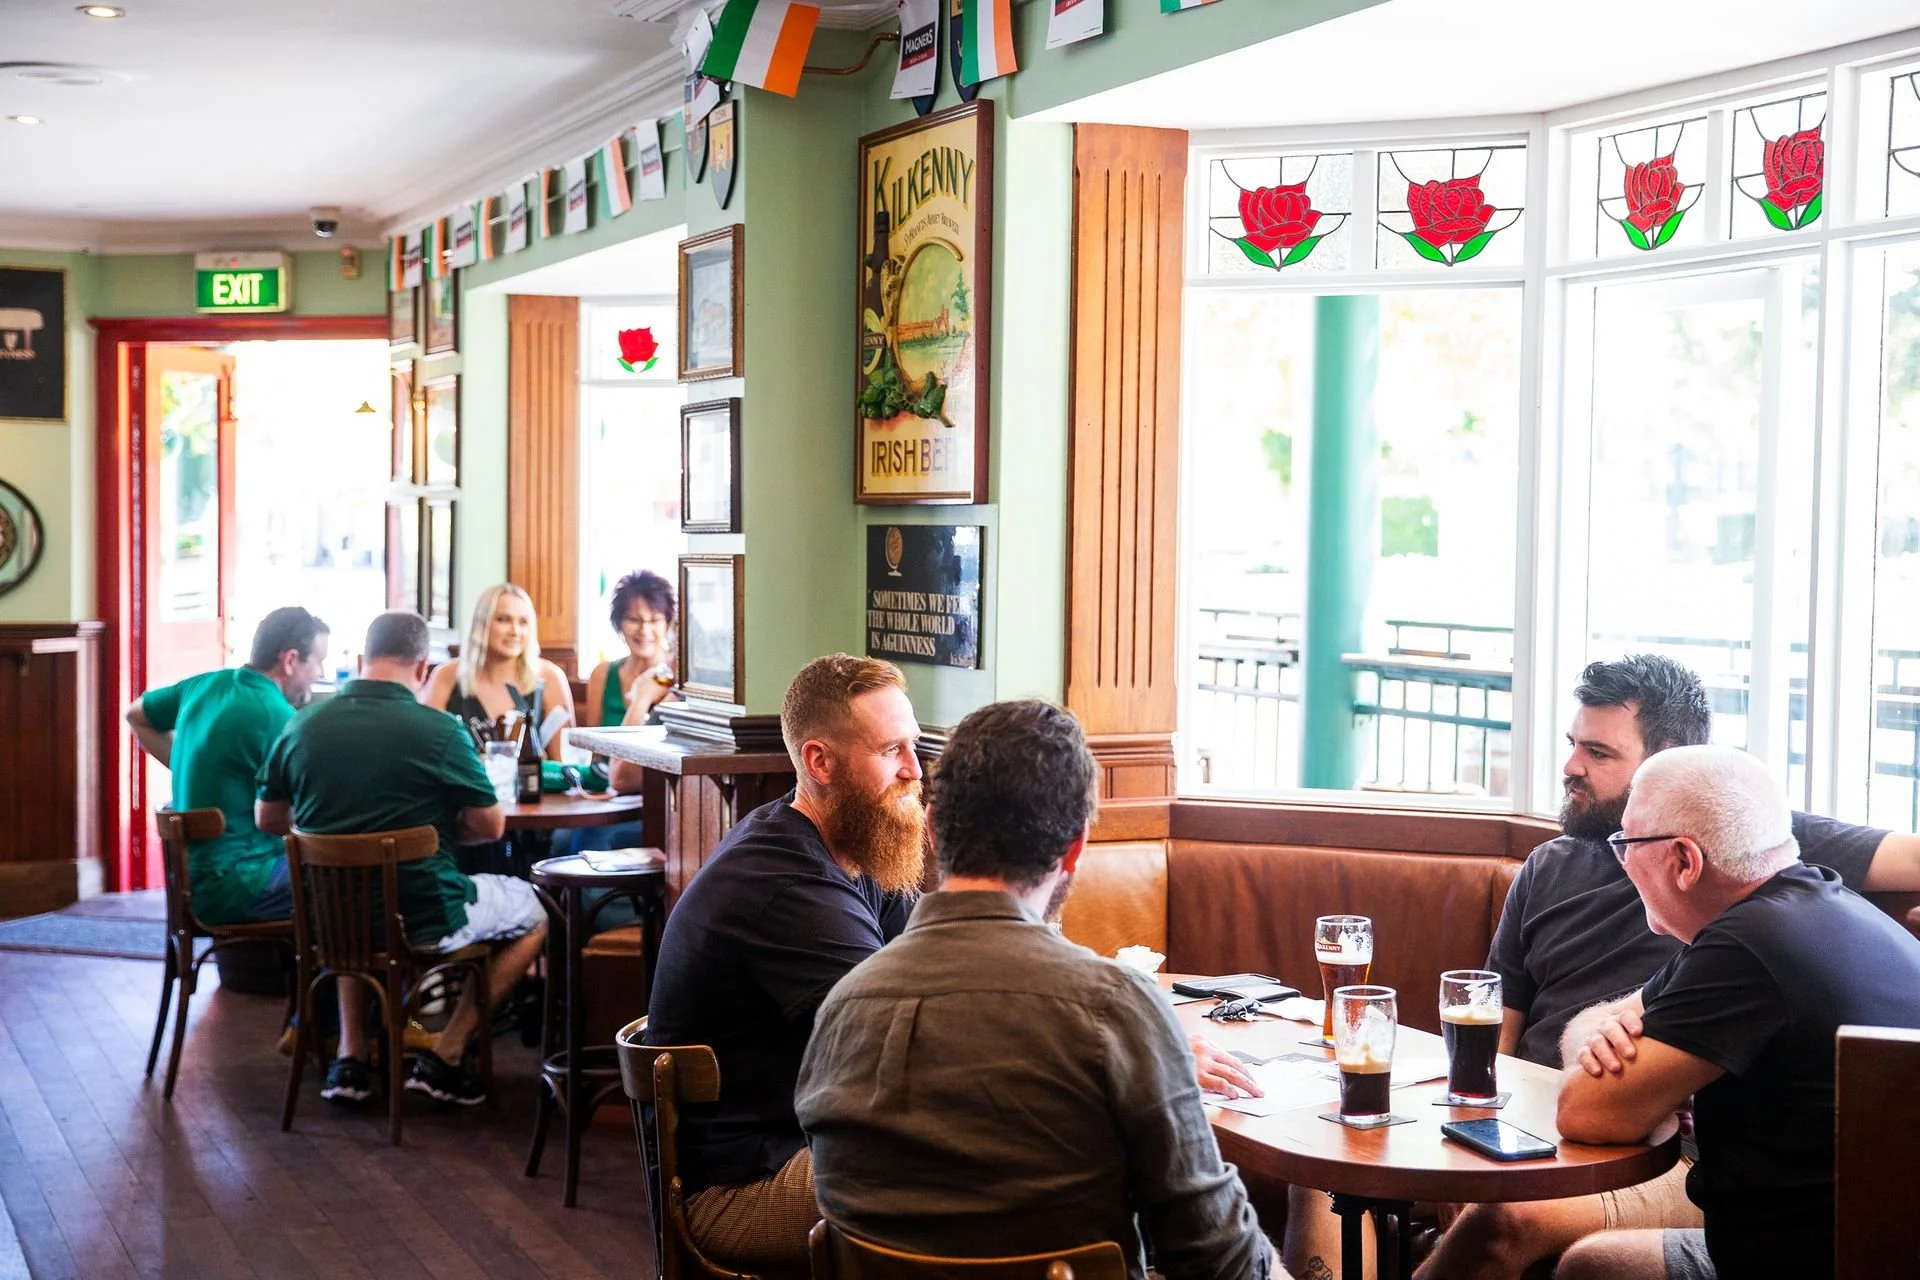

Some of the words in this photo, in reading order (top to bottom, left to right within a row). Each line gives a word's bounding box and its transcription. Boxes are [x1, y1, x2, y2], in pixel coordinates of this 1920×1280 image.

[904, 29, 934, 55] MAGNERS
[873, 146, 974, 233] KILKENNY
[212, 273, 264, 305] EXIT
[871, 439, 917, 474] IRISH
[873, 590, 926, 611] SOMETIMES
[928, 593, 944, 613] WE
[868, 609, 885, 629] THE
[886, 611, 919, 632] WHOLE
[920, 614, 956, 635] WORLD
[871, 631, 880, 649] IS
